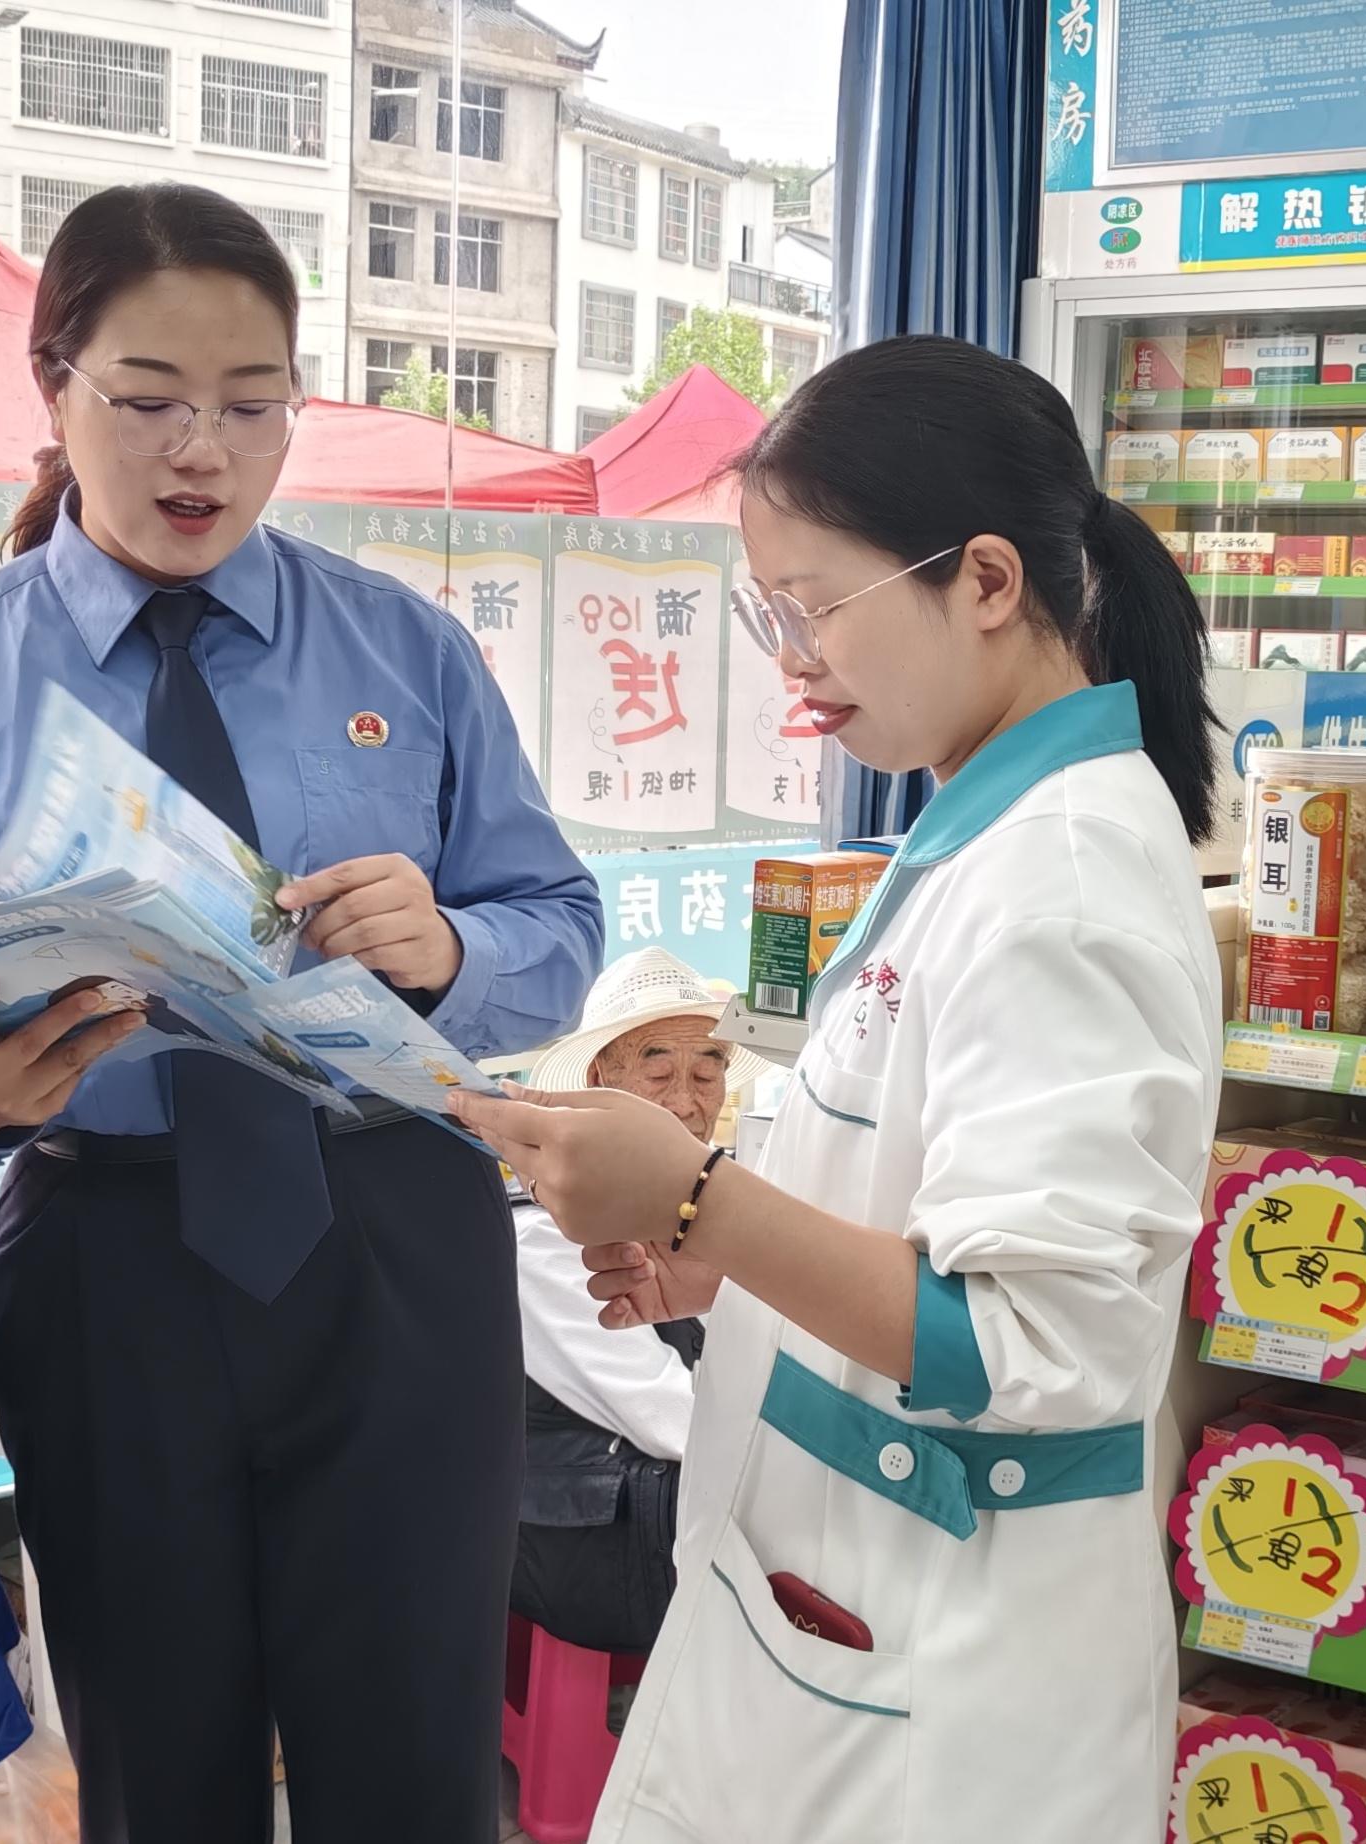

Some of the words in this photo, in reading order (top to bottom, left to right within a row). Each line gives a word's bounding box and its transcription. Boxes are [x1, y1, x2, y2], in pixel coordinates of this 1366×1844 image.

[1105, 257, 1137, 270] 处方药
[1263, 815, 1288, 891] 银耳
